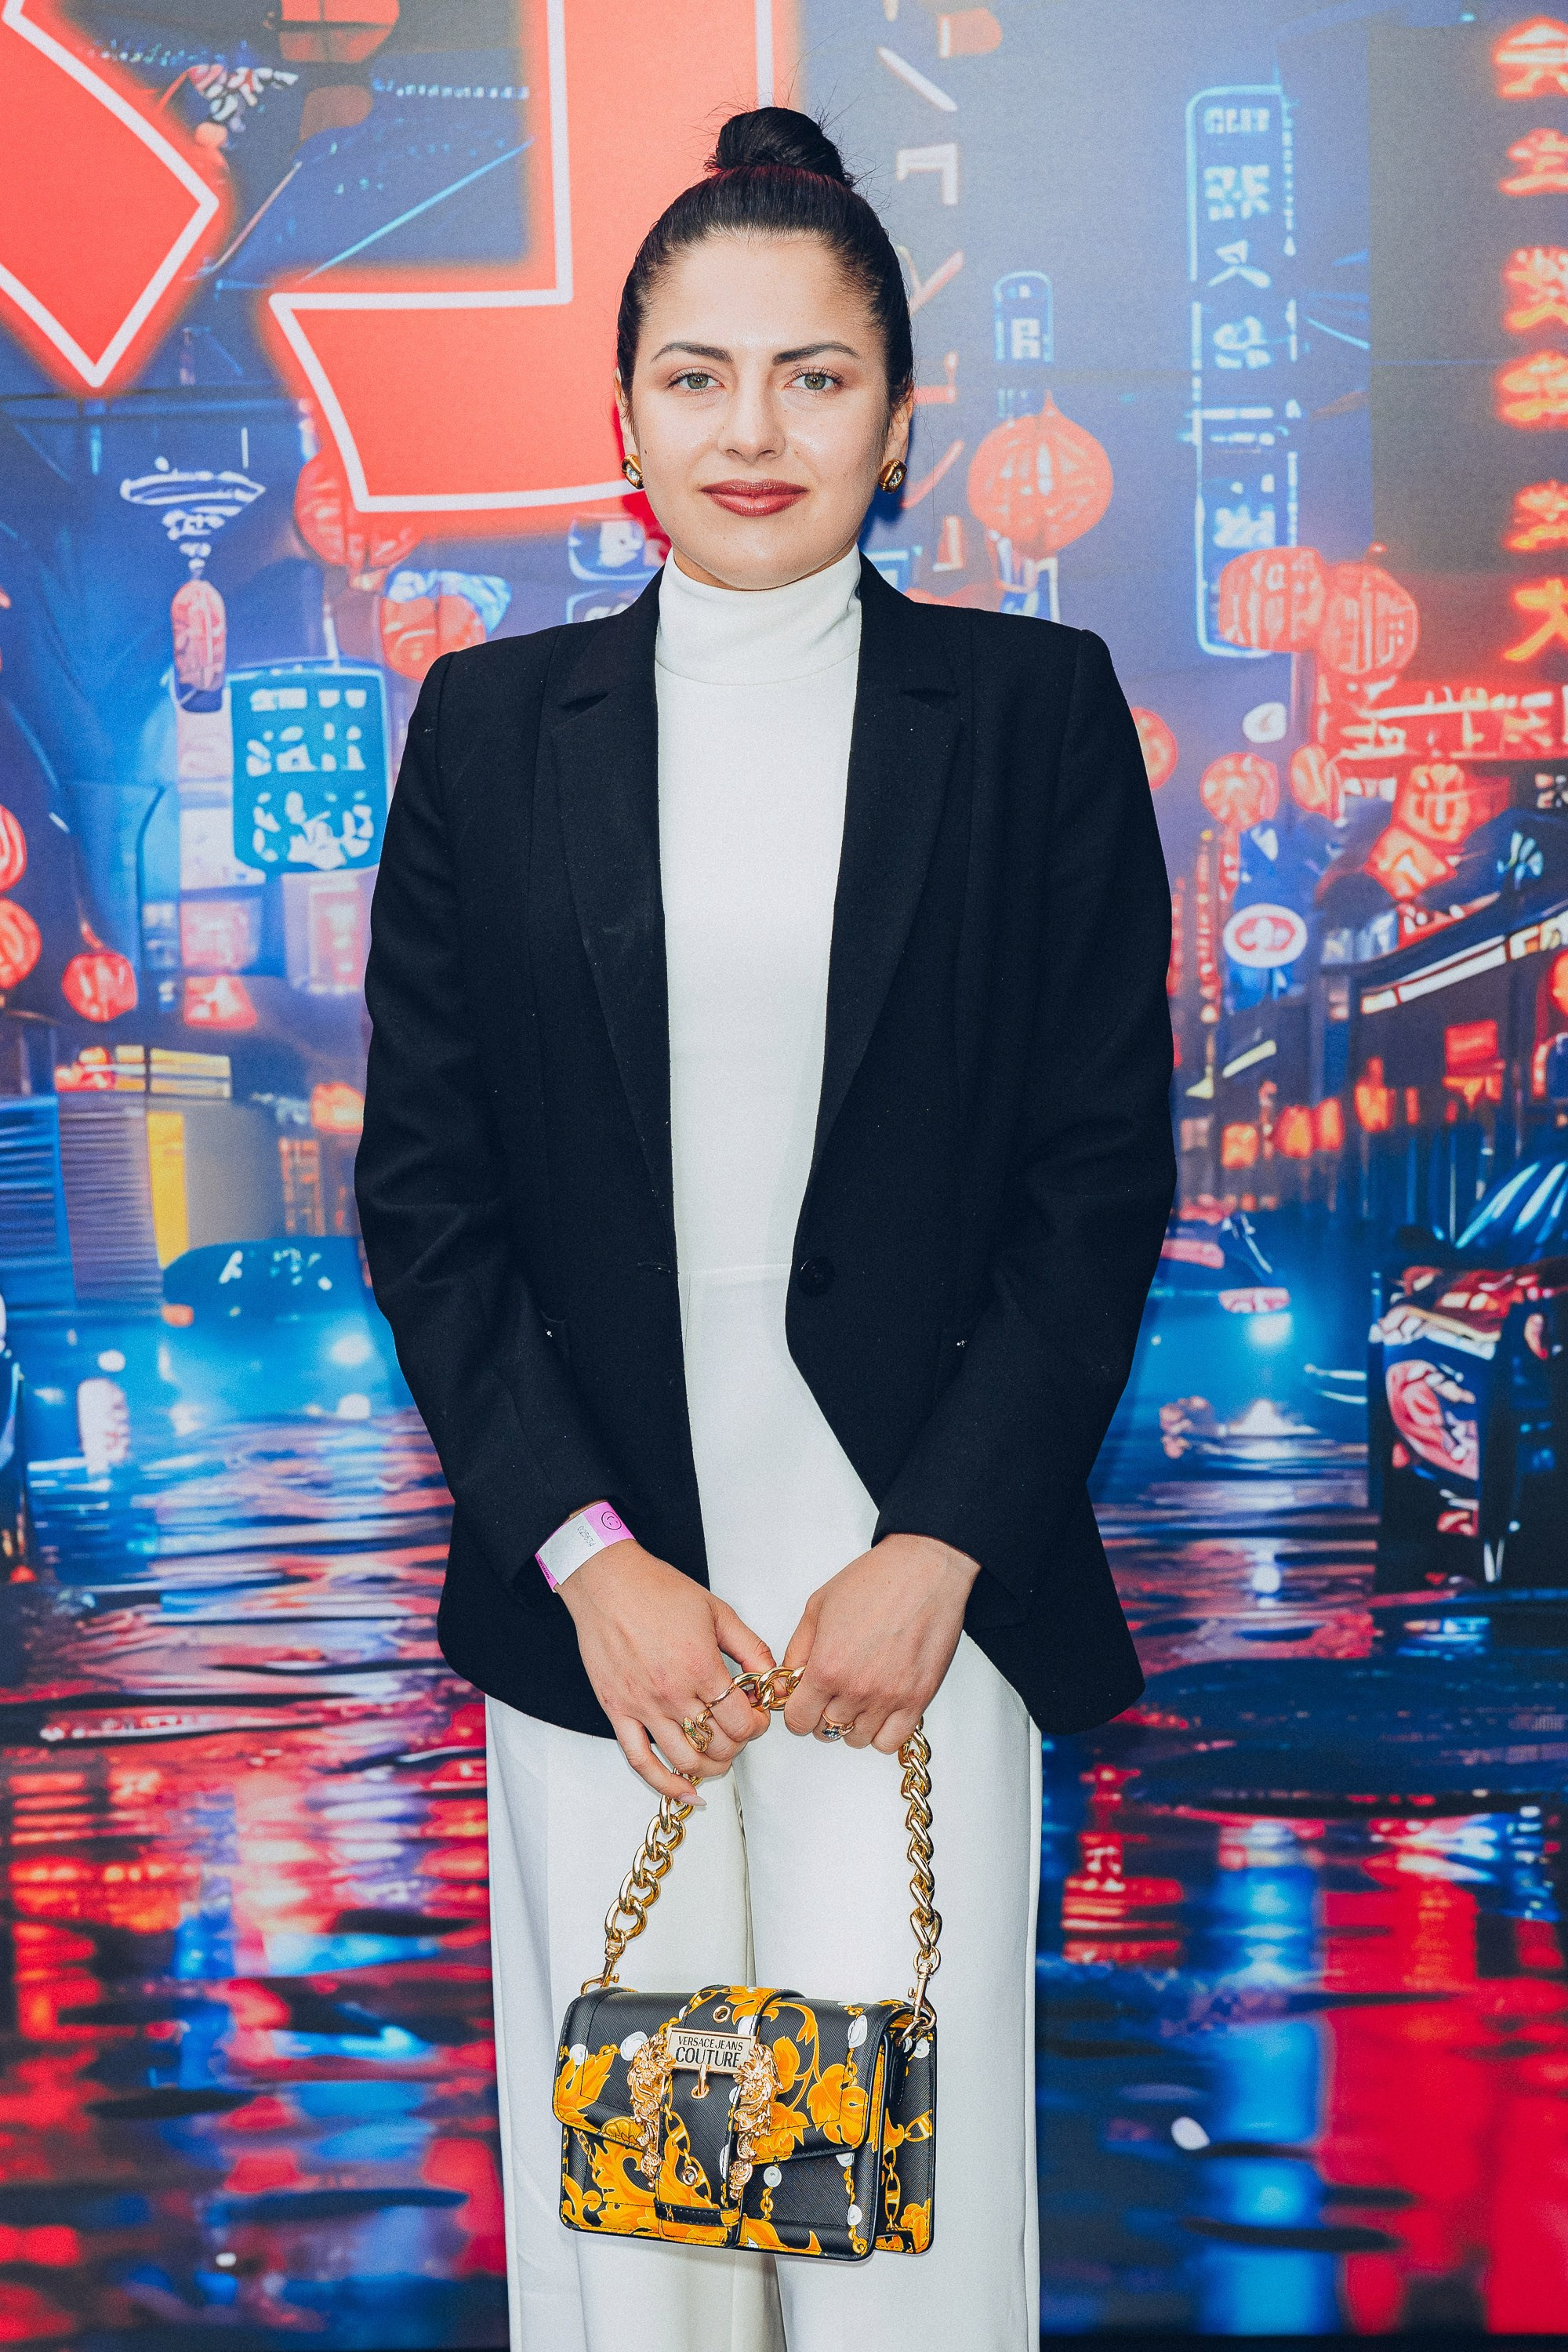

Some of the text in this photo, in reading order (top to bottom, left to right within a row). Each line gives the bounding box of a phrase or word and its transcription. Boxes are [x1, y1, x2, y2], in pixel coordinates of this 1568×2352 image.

[678, 2035, 743, 2051] VERSACE JEANS
[675, 2046, 741, 2068] COUTURE
